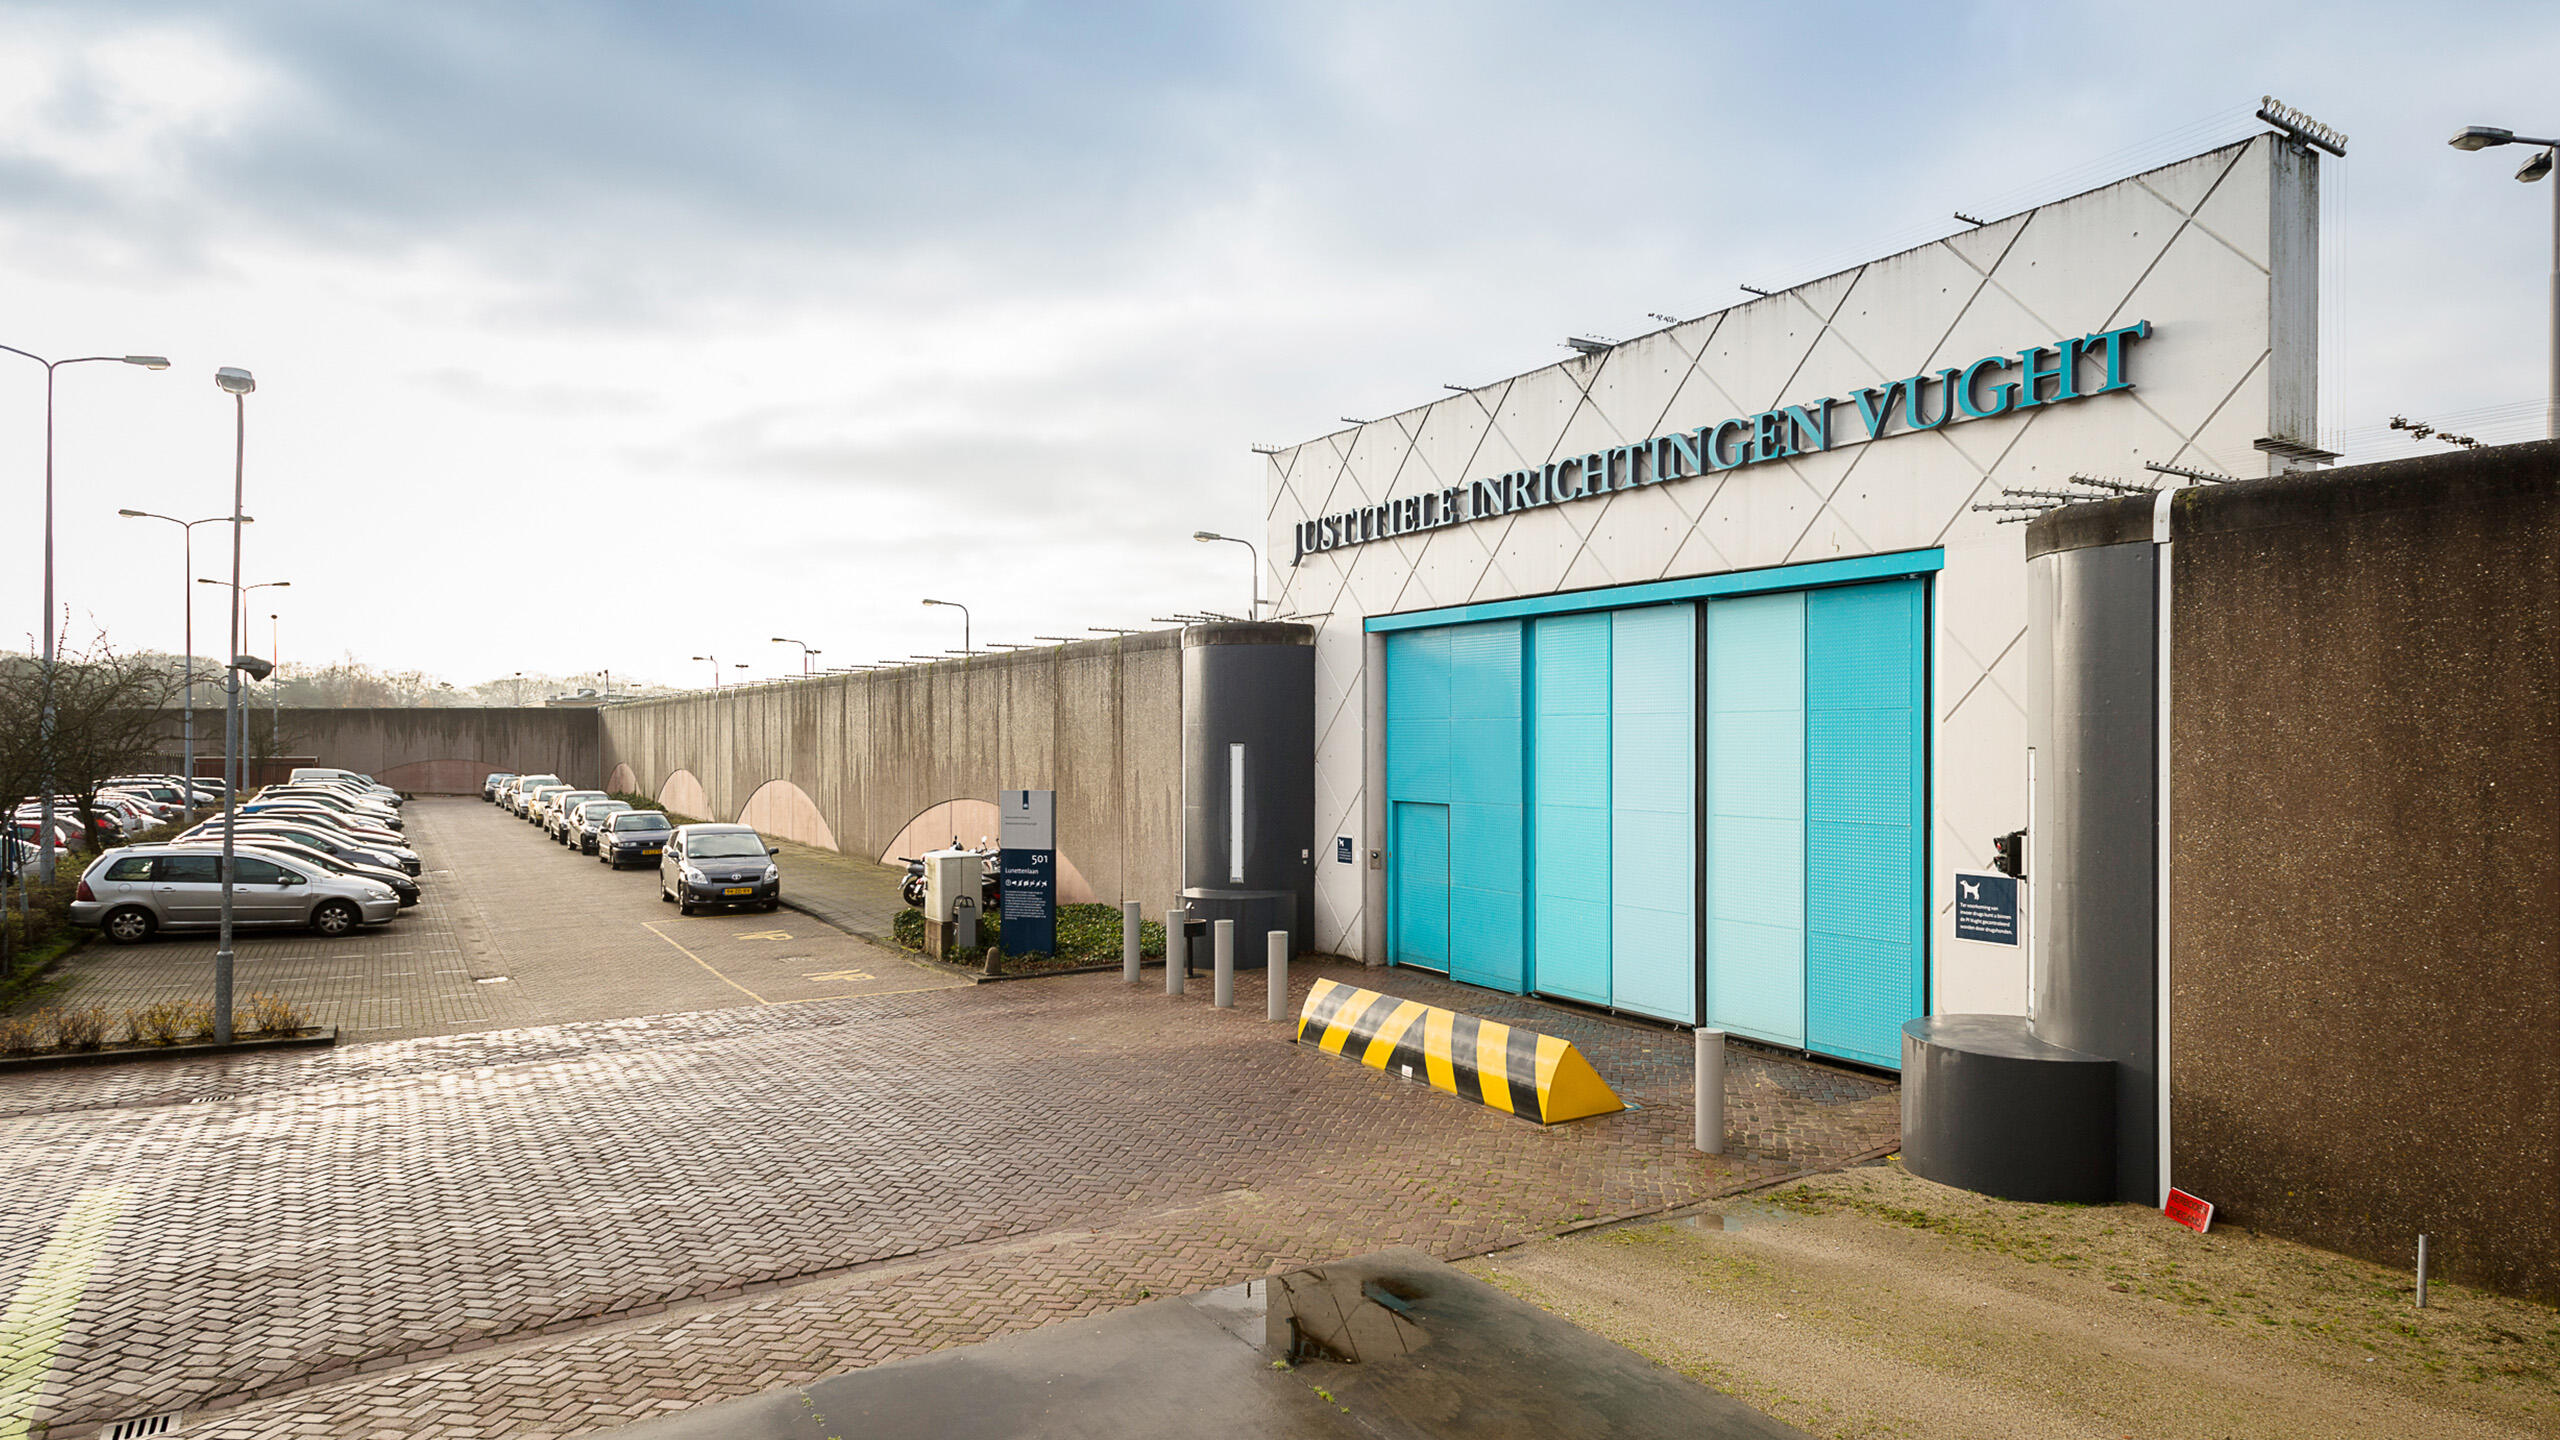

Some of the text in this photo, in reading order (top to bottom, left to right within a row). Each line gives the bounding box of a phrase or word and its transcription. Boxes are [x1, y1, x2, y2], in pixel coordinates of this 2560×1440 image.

[1289, 319, 2152, 567] JUSTITIELE INRICHTINGEN VUGHT
[1031, 854, 1048, 865] 501
[1004, 867, 1039, 875] Lunettenlaan
